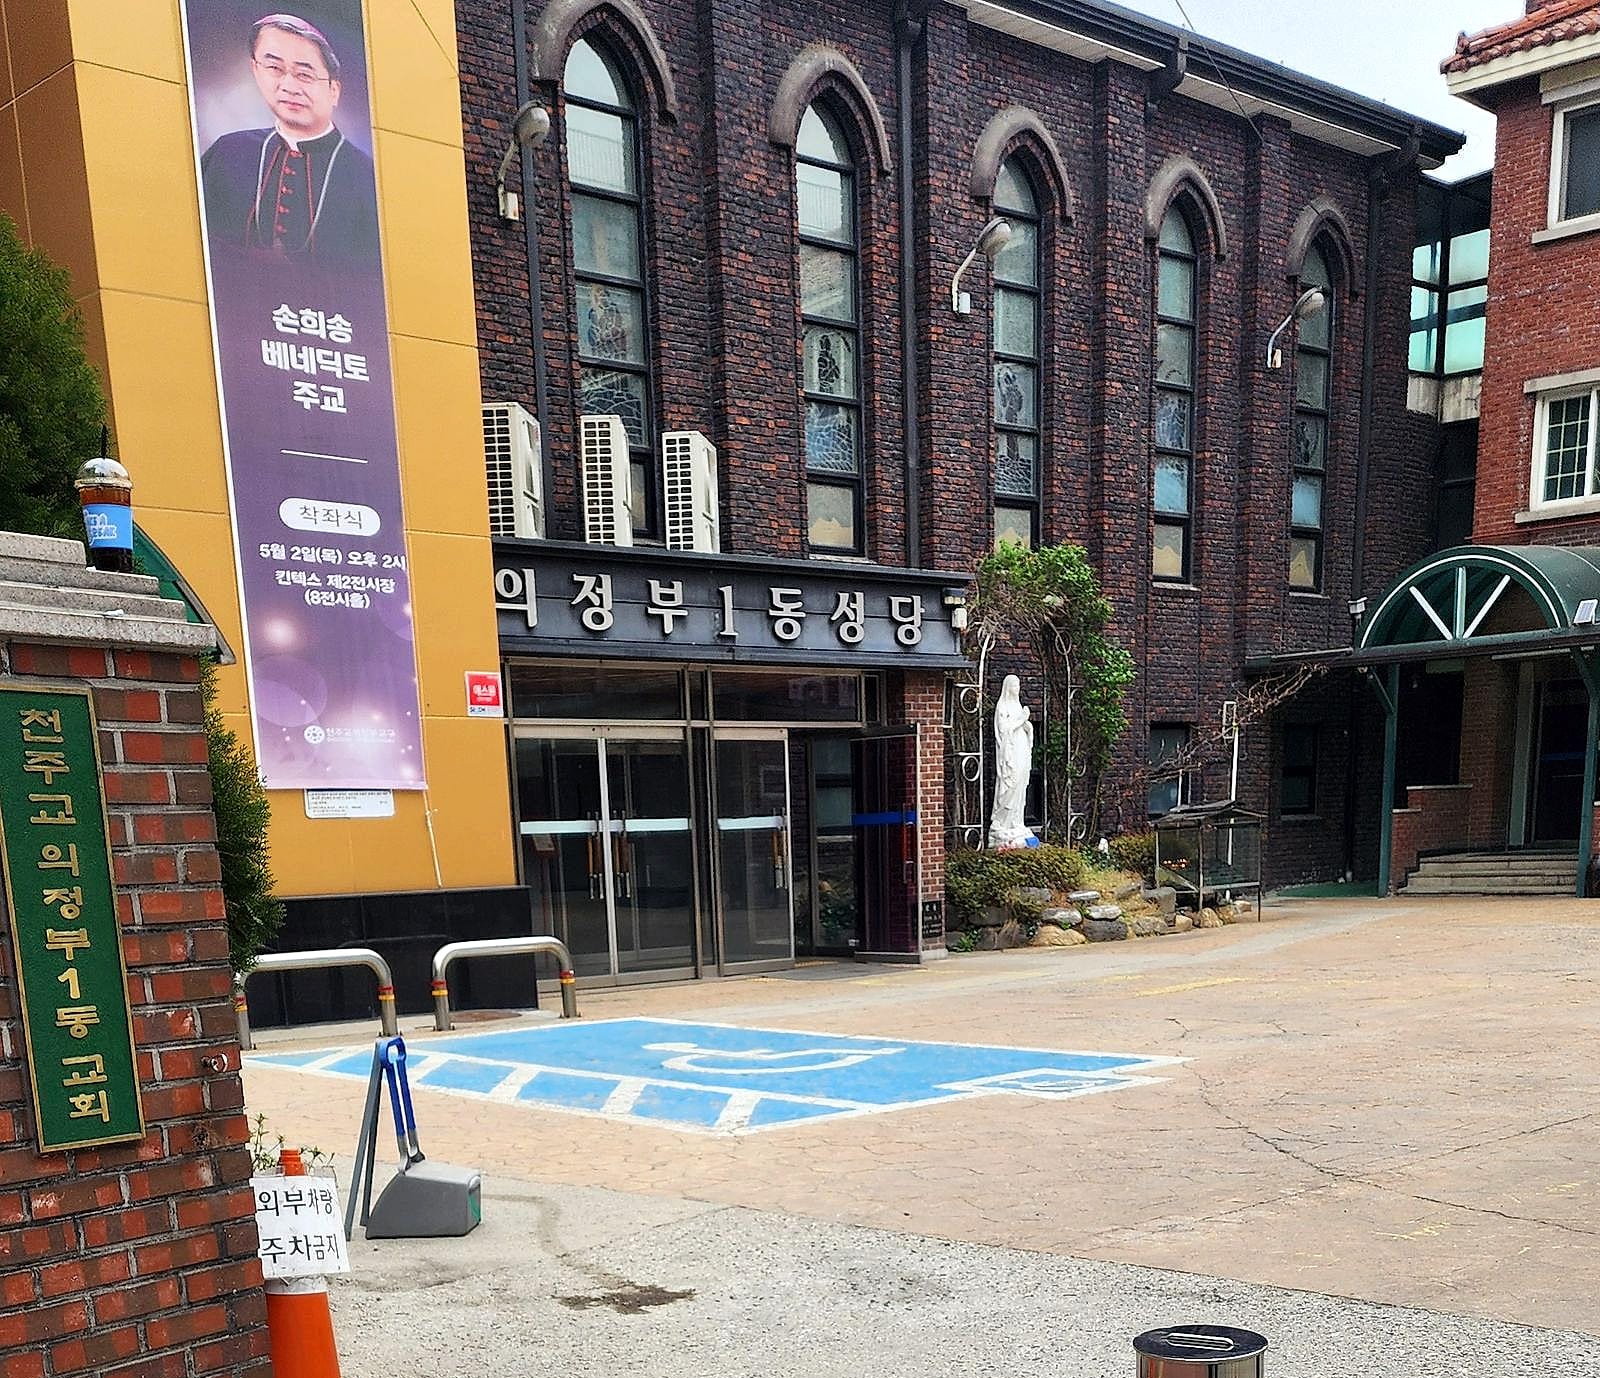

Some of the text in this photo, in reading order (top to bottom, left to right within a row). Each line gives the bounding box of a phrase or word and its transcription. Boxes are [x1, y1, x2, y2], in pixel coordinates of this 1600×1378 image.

[272, 303, 353, 344] 손희송
[261, 340, 370, 382] 베네딕토
[293, 380, 348, 414] 주교
[300, 504, 363, 529] 착좌식
[259, 542, 407, 572] 5월 2일(목) 오후 2시
[275, 569, 396, 594] 킨텍스 제2전시장
[261, 1233, 340, 1264] 주차금지
